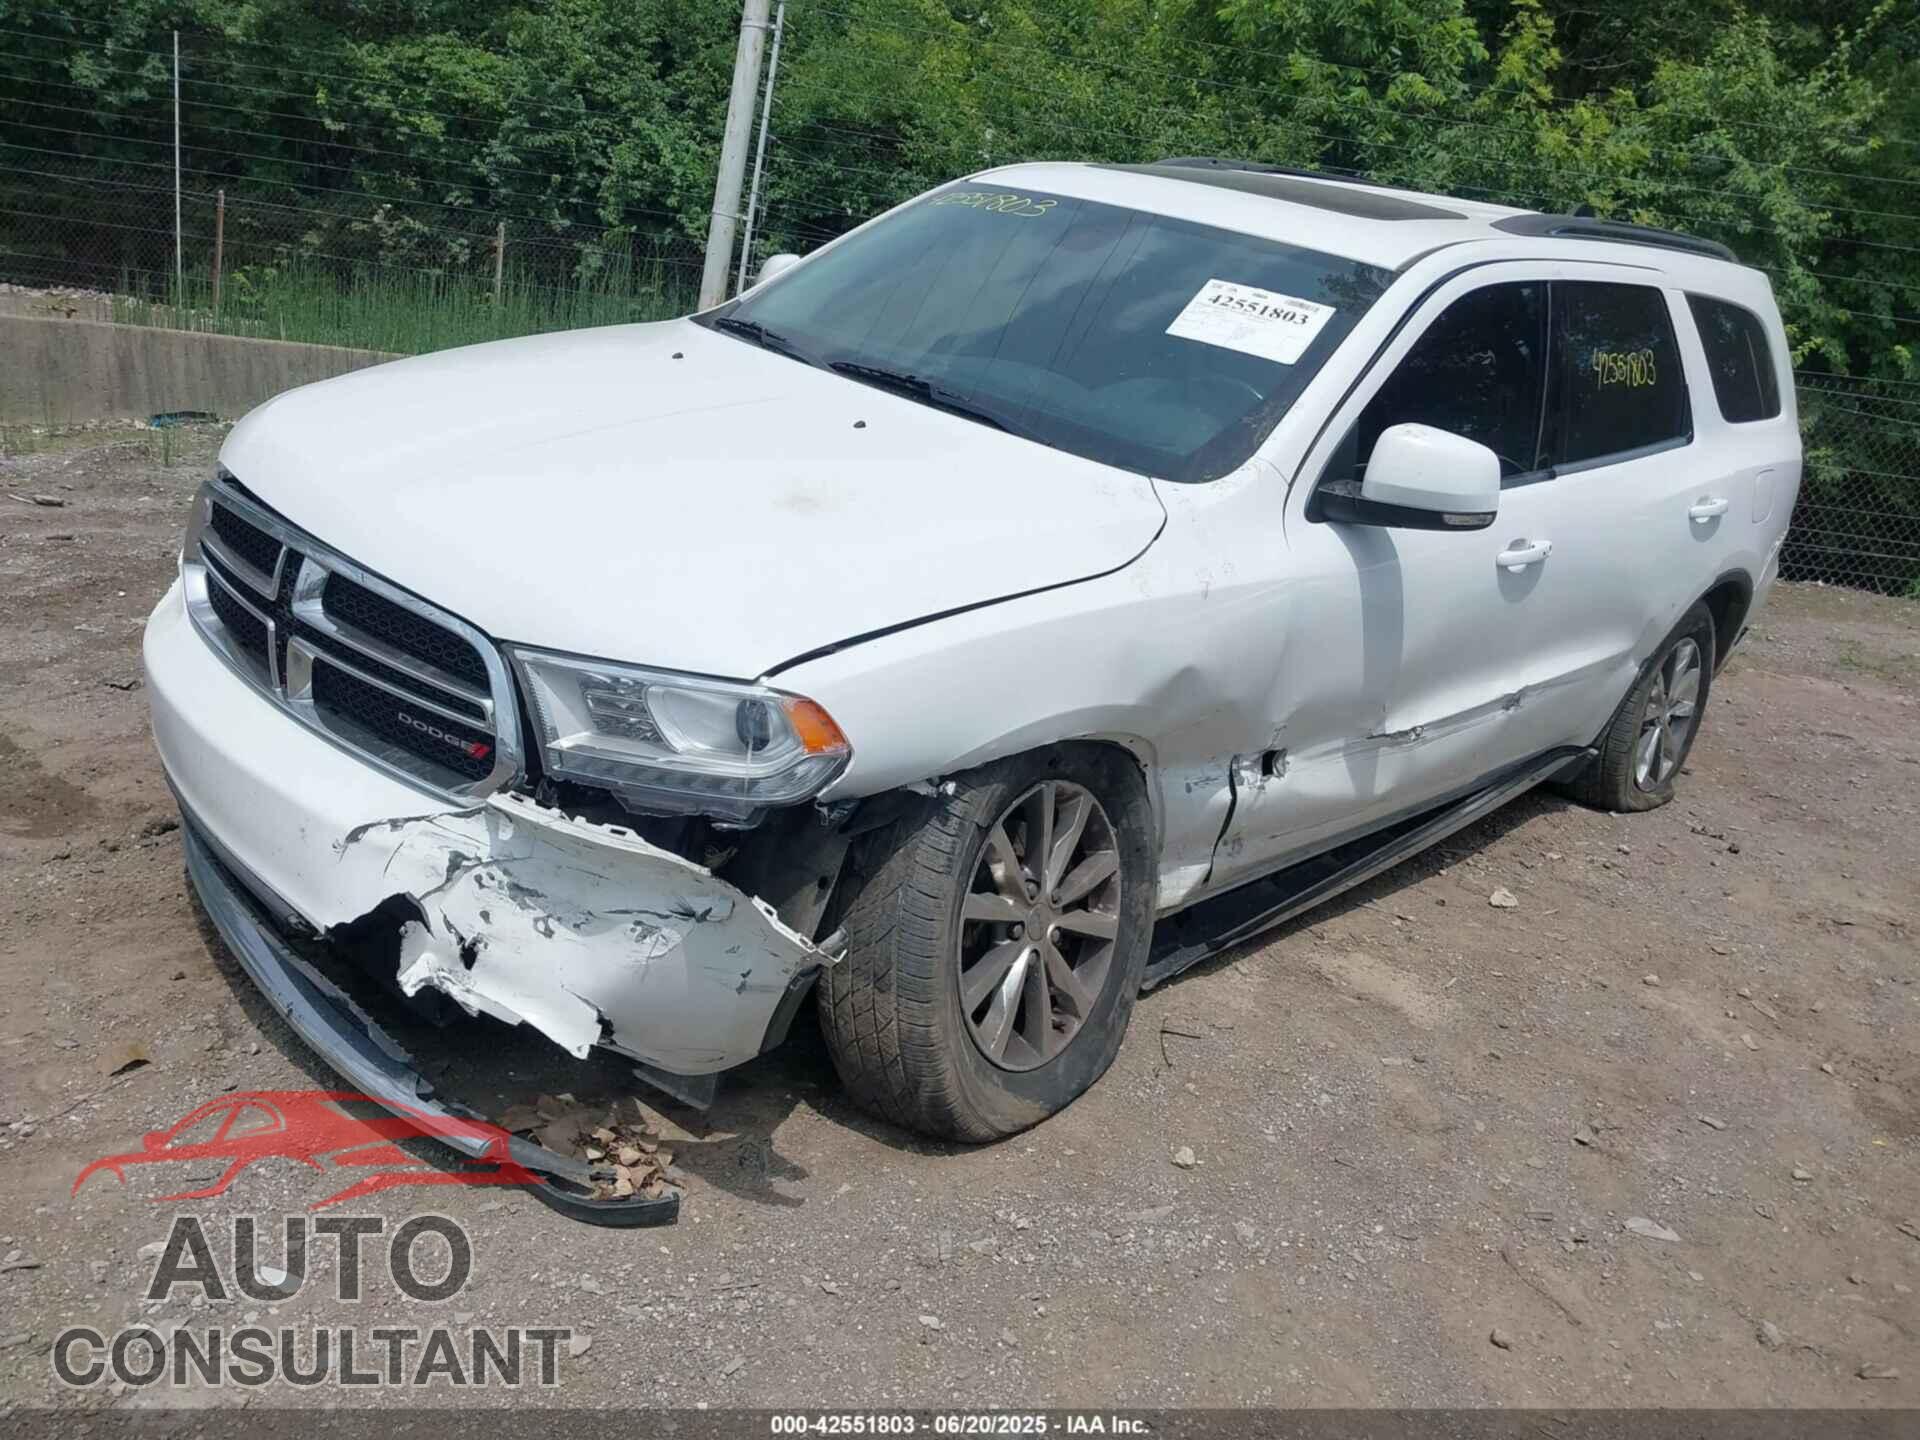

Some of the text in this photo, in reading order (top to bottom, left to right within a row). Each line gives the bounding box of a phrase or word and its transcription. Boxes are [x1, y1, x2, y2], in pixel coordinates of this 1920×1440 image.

[1208, 294, 1309, 325] 42551803
[1592, 347, 1656, 391] 42551803
[398, 711, 476, 753] DODGE
